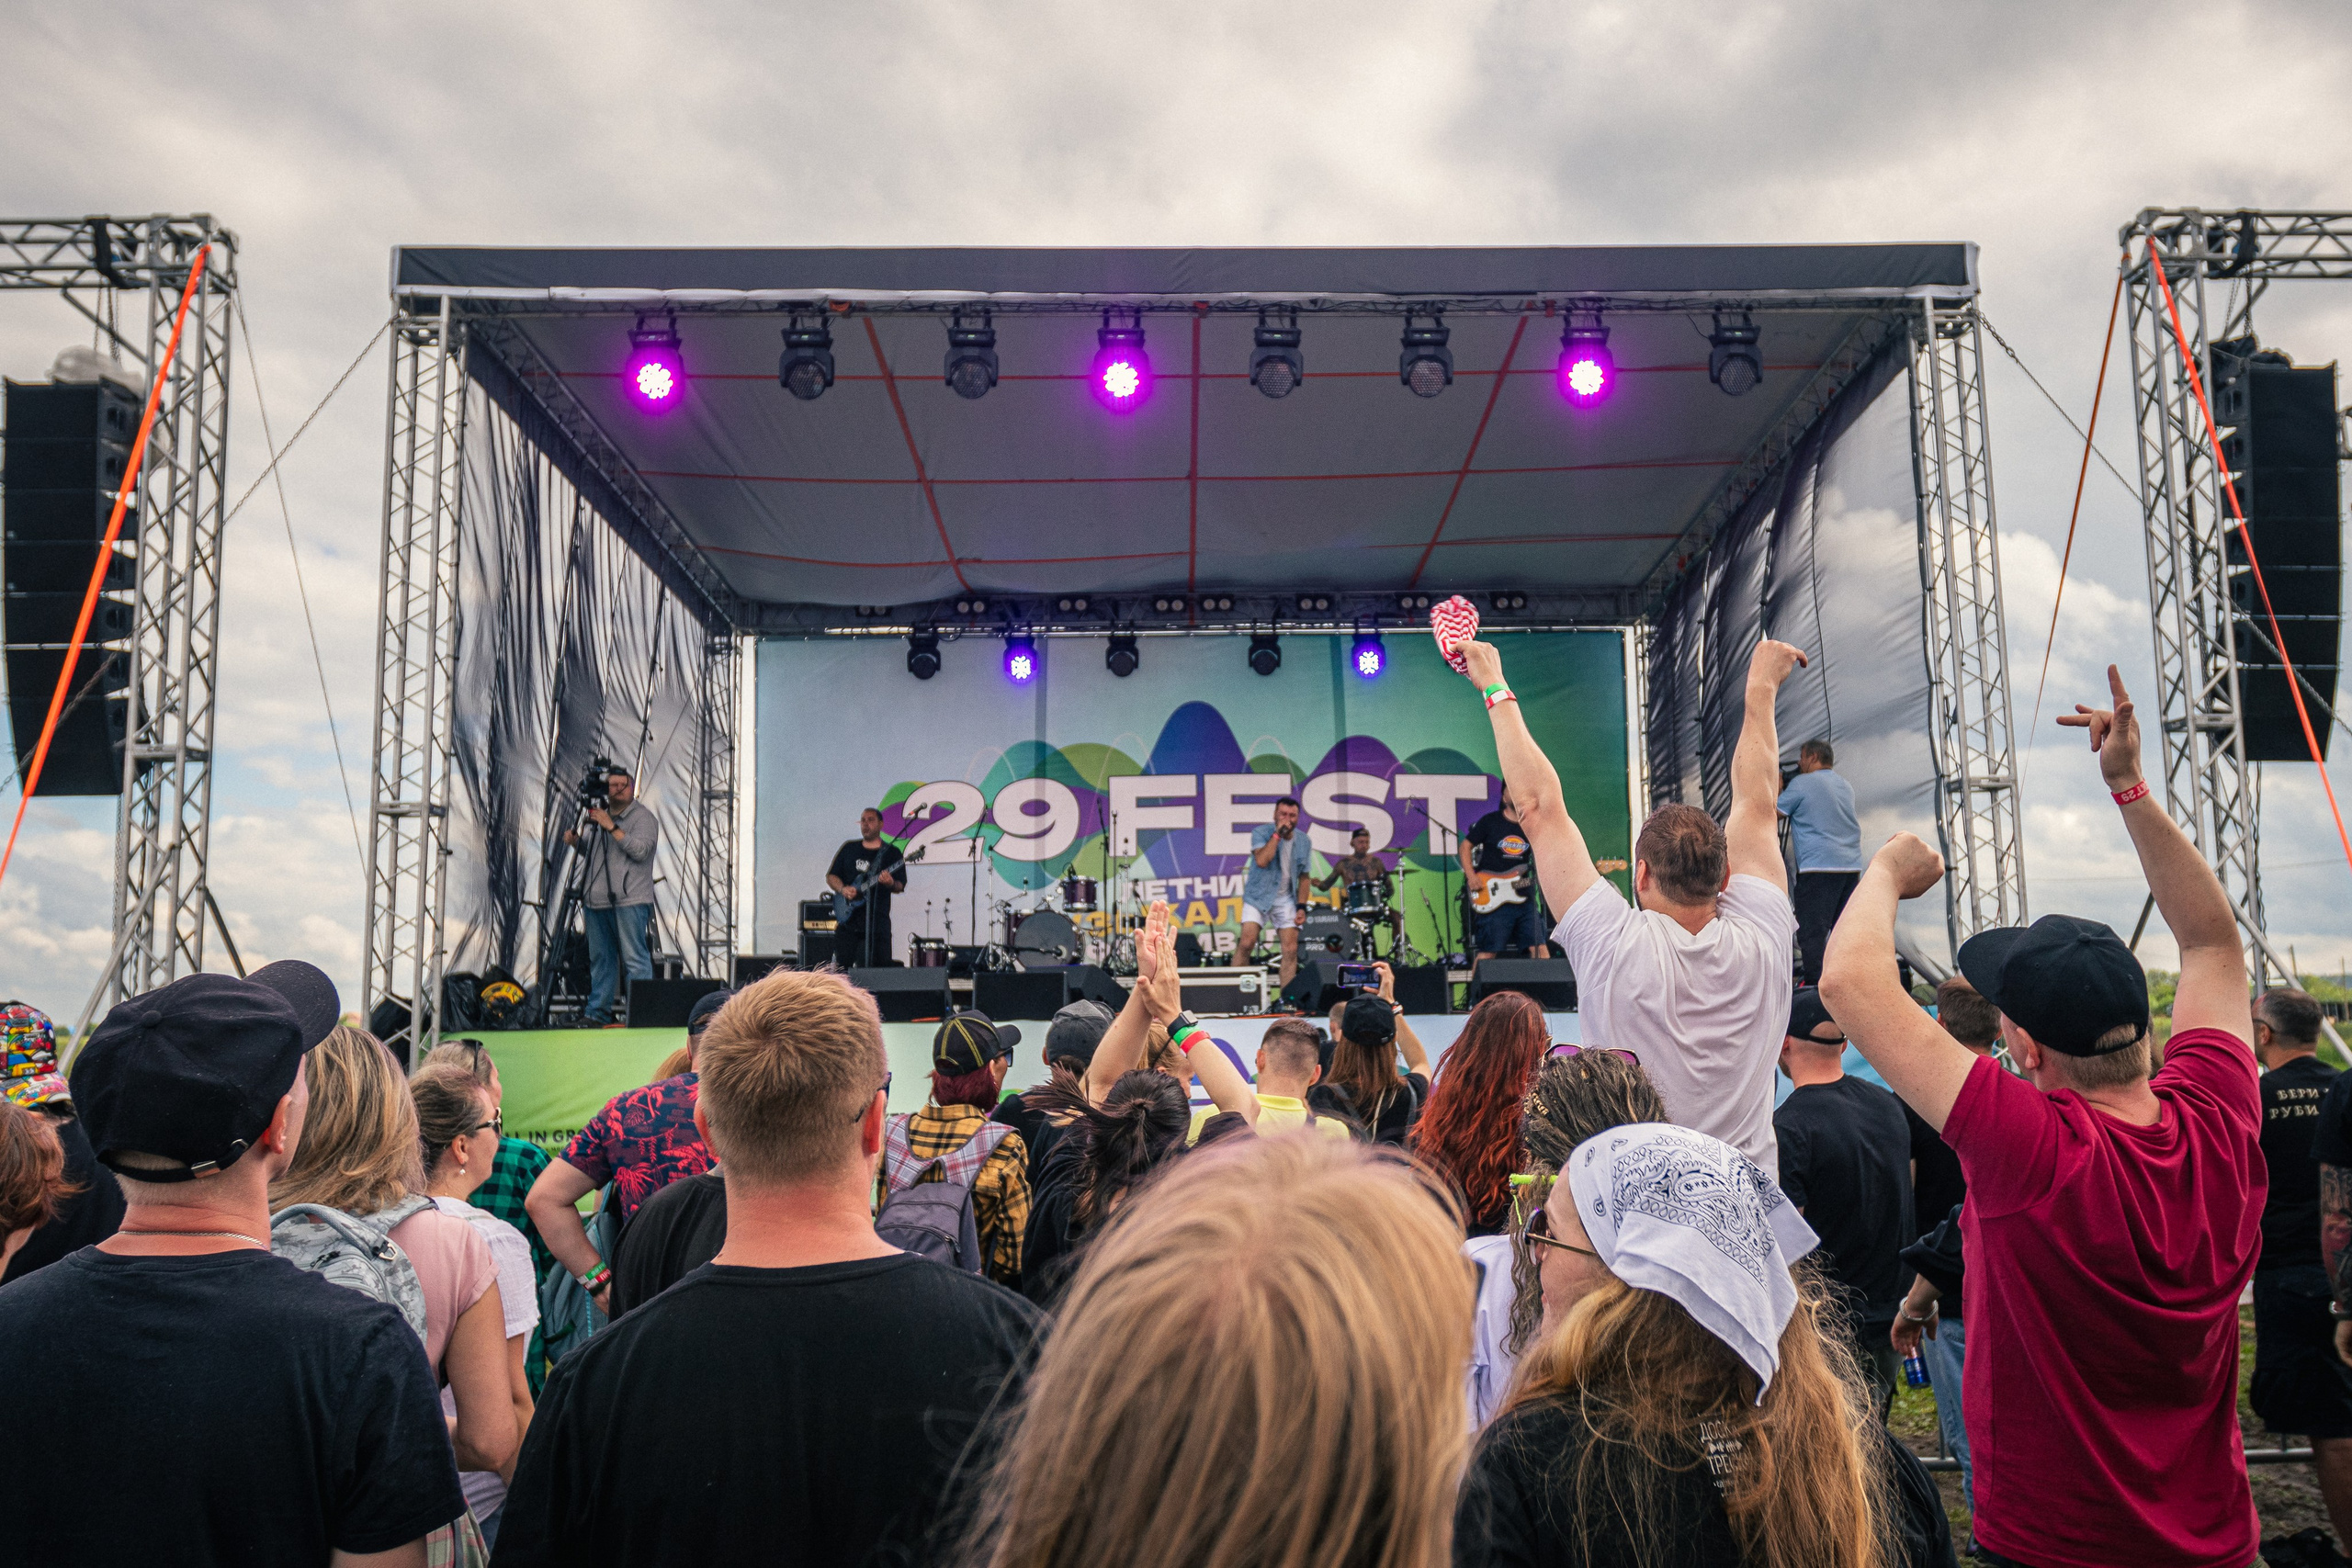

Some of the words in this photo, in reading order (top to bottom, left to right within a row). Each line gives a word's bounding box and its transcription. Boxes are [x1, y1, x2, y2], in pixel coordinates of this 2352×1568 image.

[2120, 789, 2137, 802] 29
[902, 778, 1080, 865] 29
[1109, 772, 1488, 857] FEST
[1121, 874, 1249, 903] ЛЕТНИ
[2278, 1089, 2320, 1100] БЕРИ
[2269, 1105, 2320, 1119] РУБИ
[552, 1129, 583, 1144] GR
